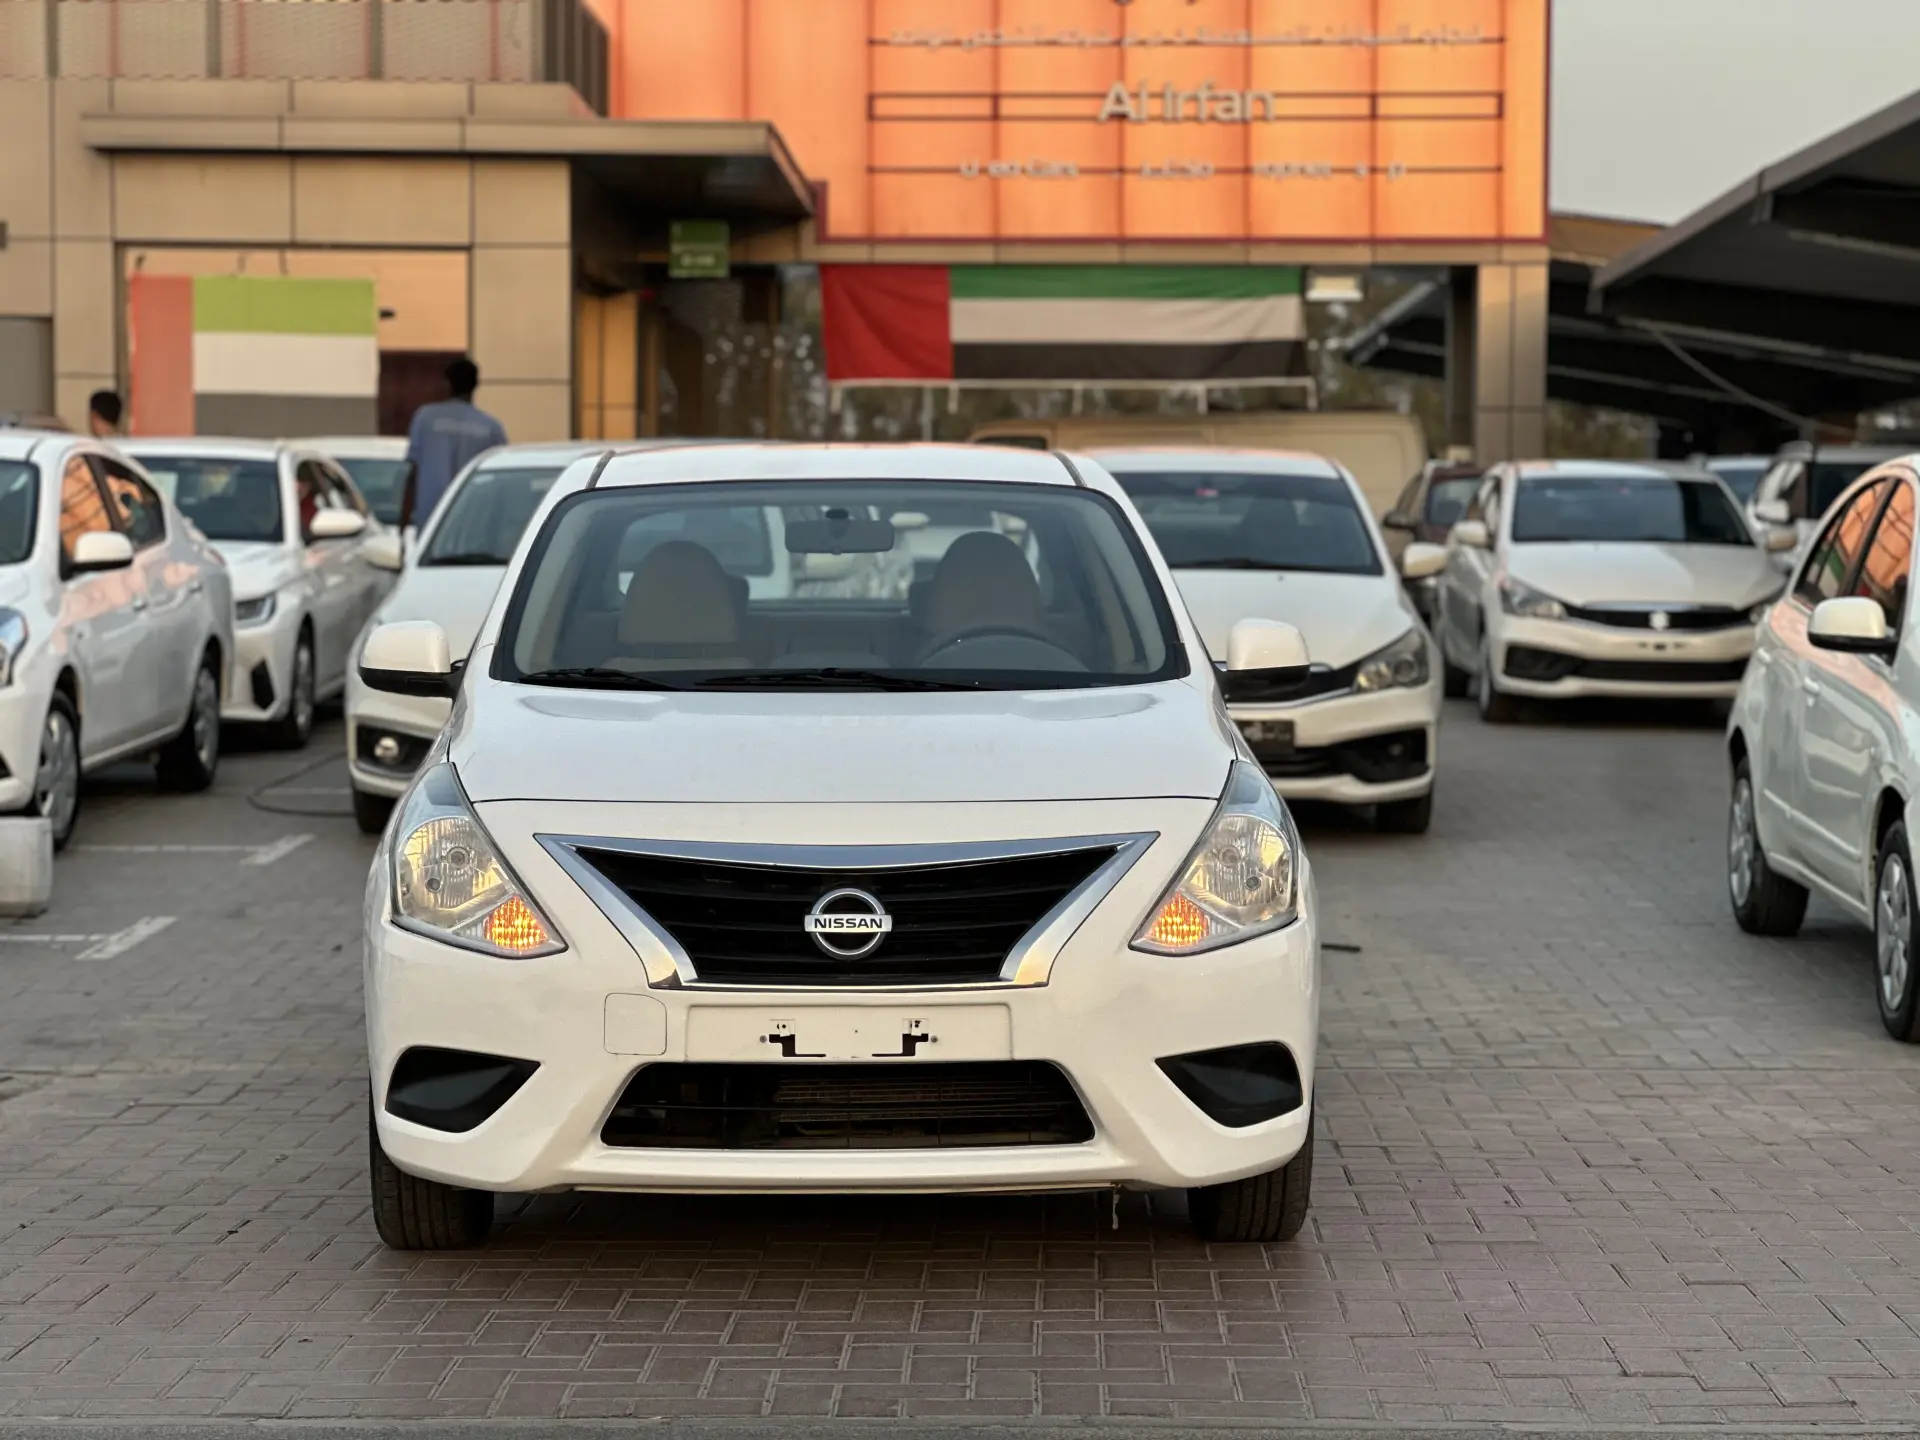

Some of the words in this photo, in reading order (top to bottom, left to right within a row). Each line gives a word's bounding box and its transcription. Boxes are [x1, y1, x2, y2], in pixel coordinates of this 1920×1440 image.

[1098, 79, 1148, 122] Al
[1163, 79, 1276, 122] Irfan
[814, 918, 883, 929] NISSAN
